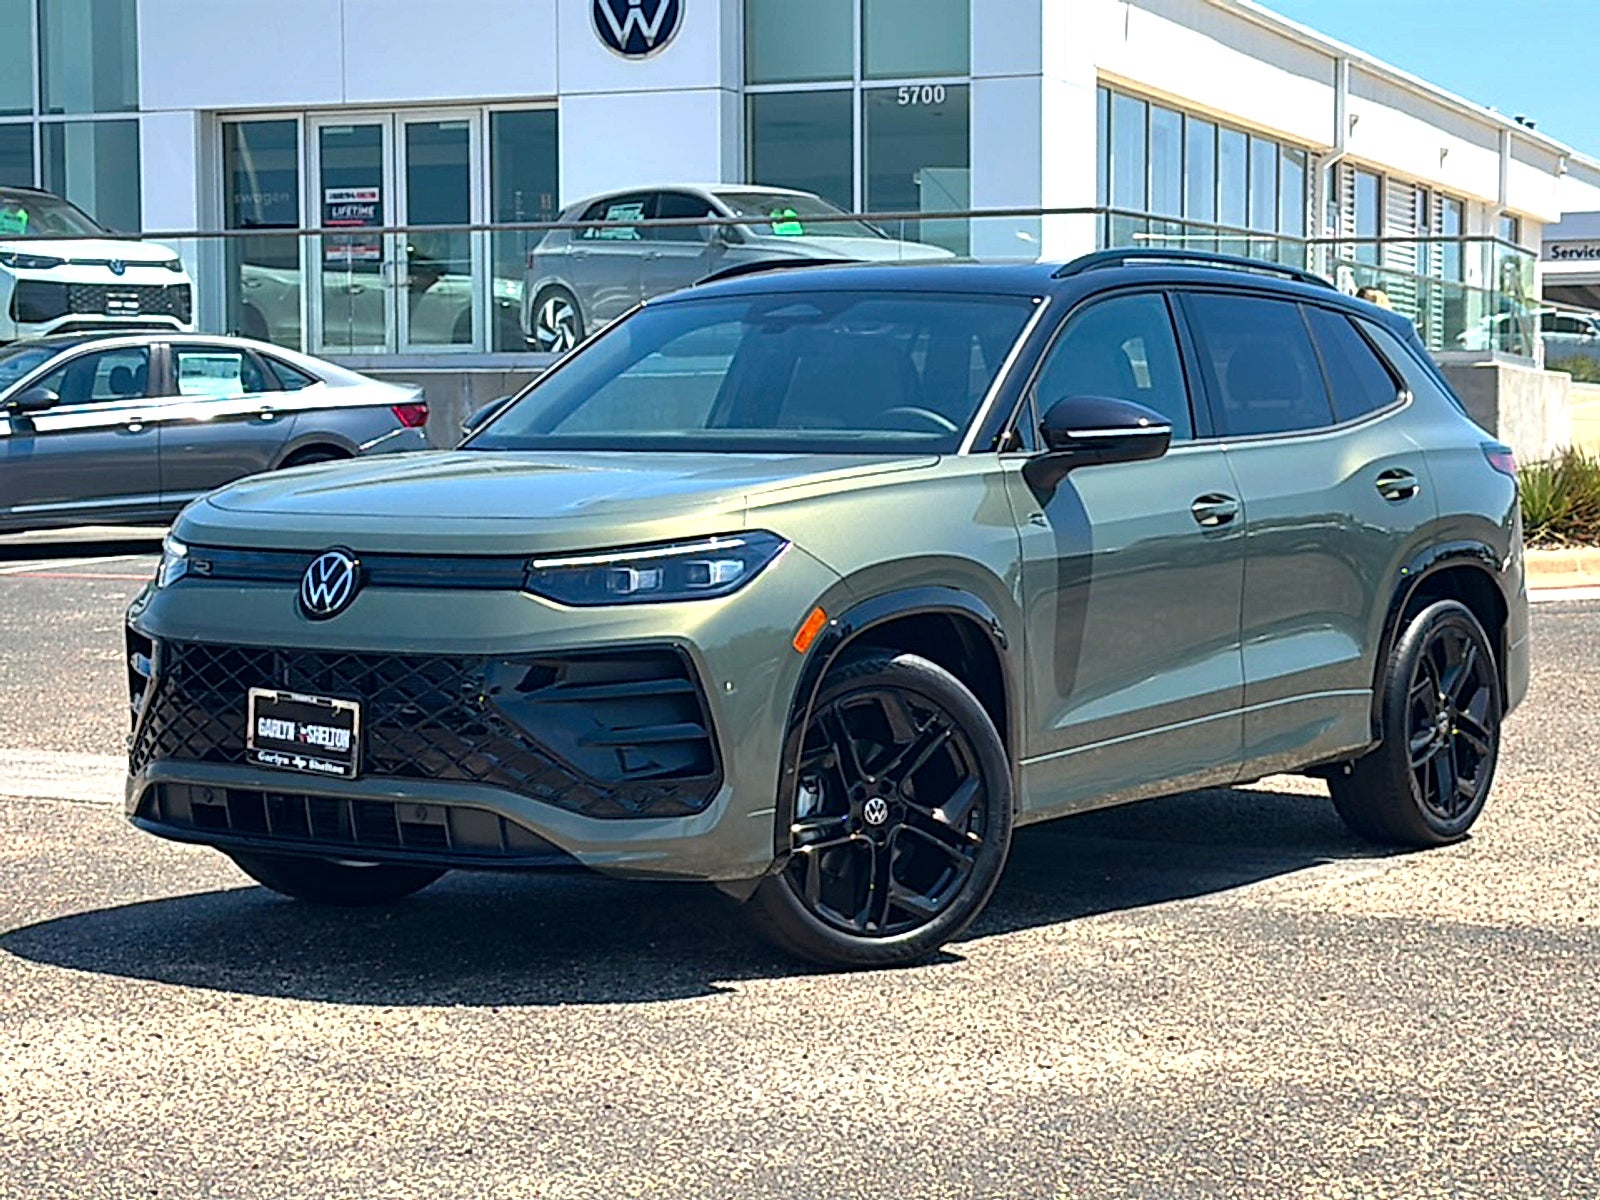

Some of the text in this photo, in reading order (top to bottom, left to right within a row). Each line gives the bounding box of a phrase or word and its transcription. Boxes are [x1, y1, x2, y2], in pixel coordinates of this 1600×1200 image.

[898, 86, 945, 105] 5700
[302, 552, 353, 613] VW
[307, 725, 351, 749] SHELTON
